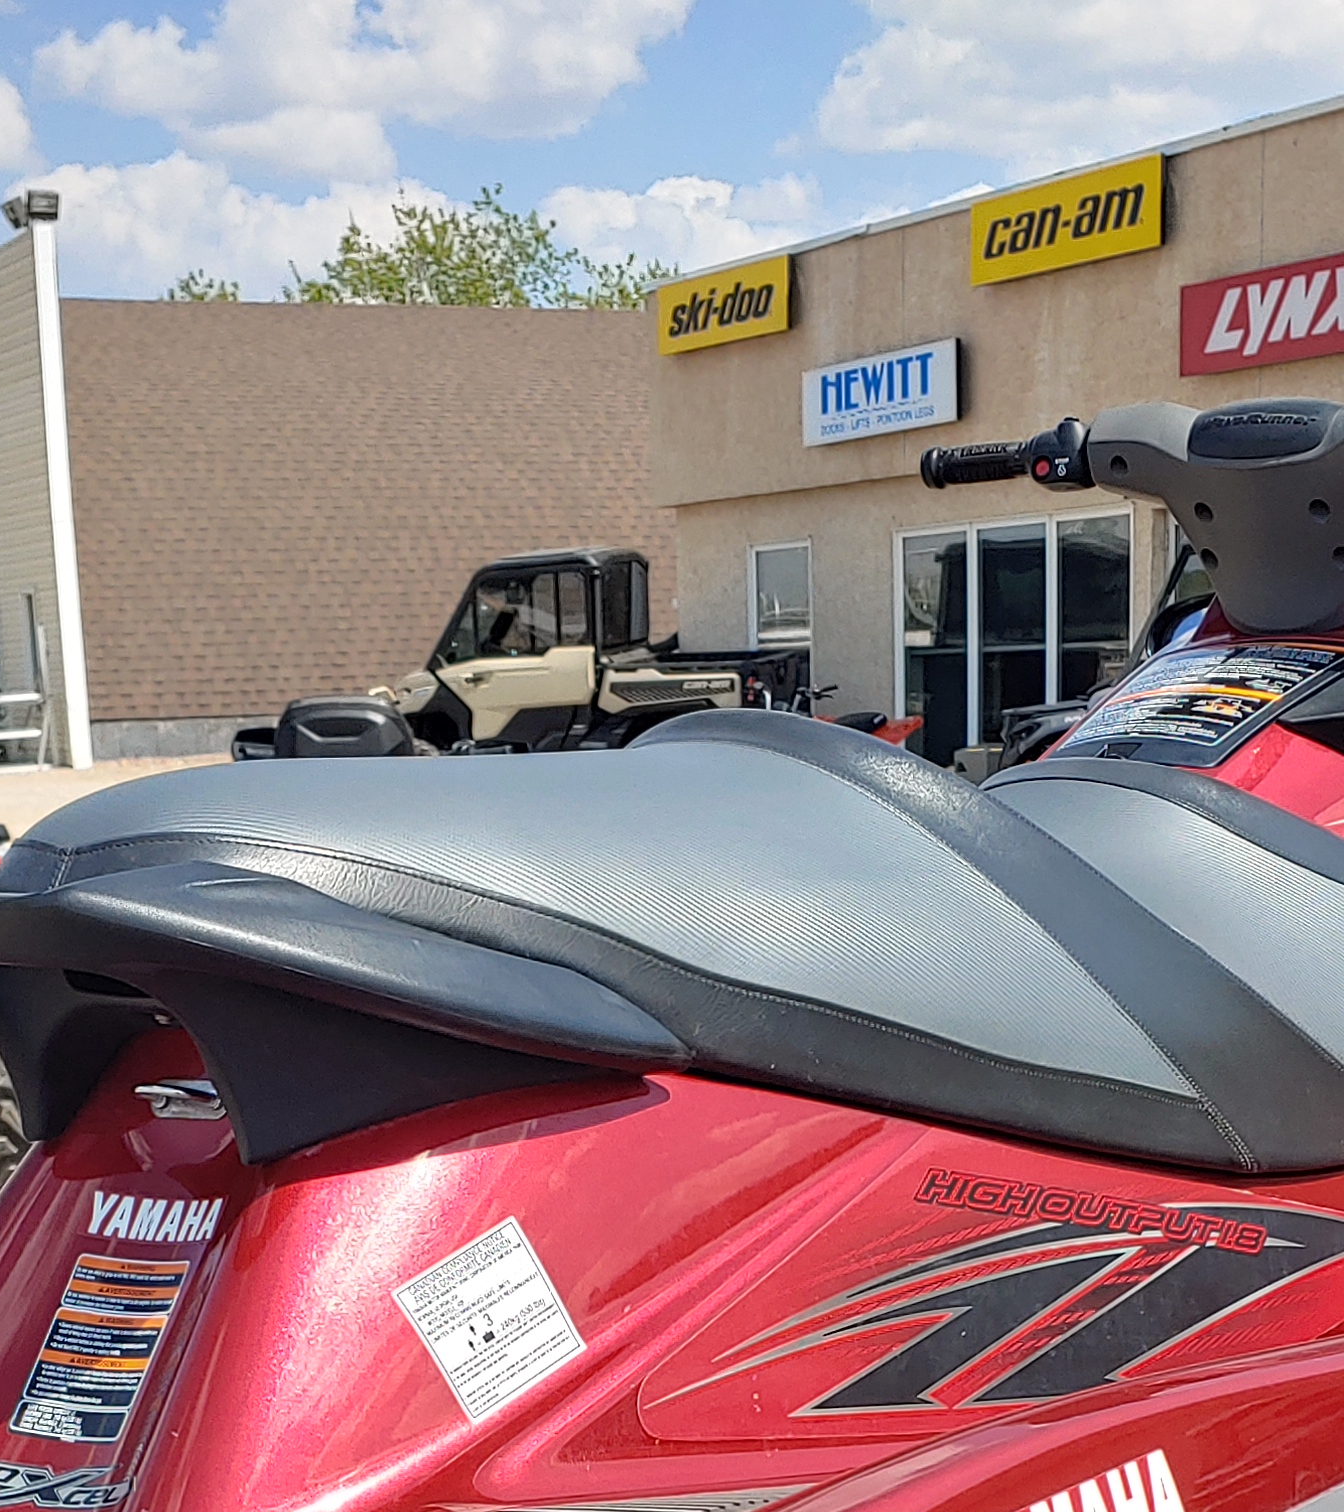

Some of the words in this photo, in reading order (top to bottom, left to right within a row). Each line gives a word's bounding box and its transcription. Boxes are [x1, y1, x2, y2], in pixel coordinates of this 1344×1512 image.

[983, 183, 1144, 260] can-am
[669, 282, 774, 337] ski-doo
[821, 352, 934, 415] HEWITT
[88, 1191, 223, 1242] YAMAHA
[481, 1312, 494, 1327] 3
